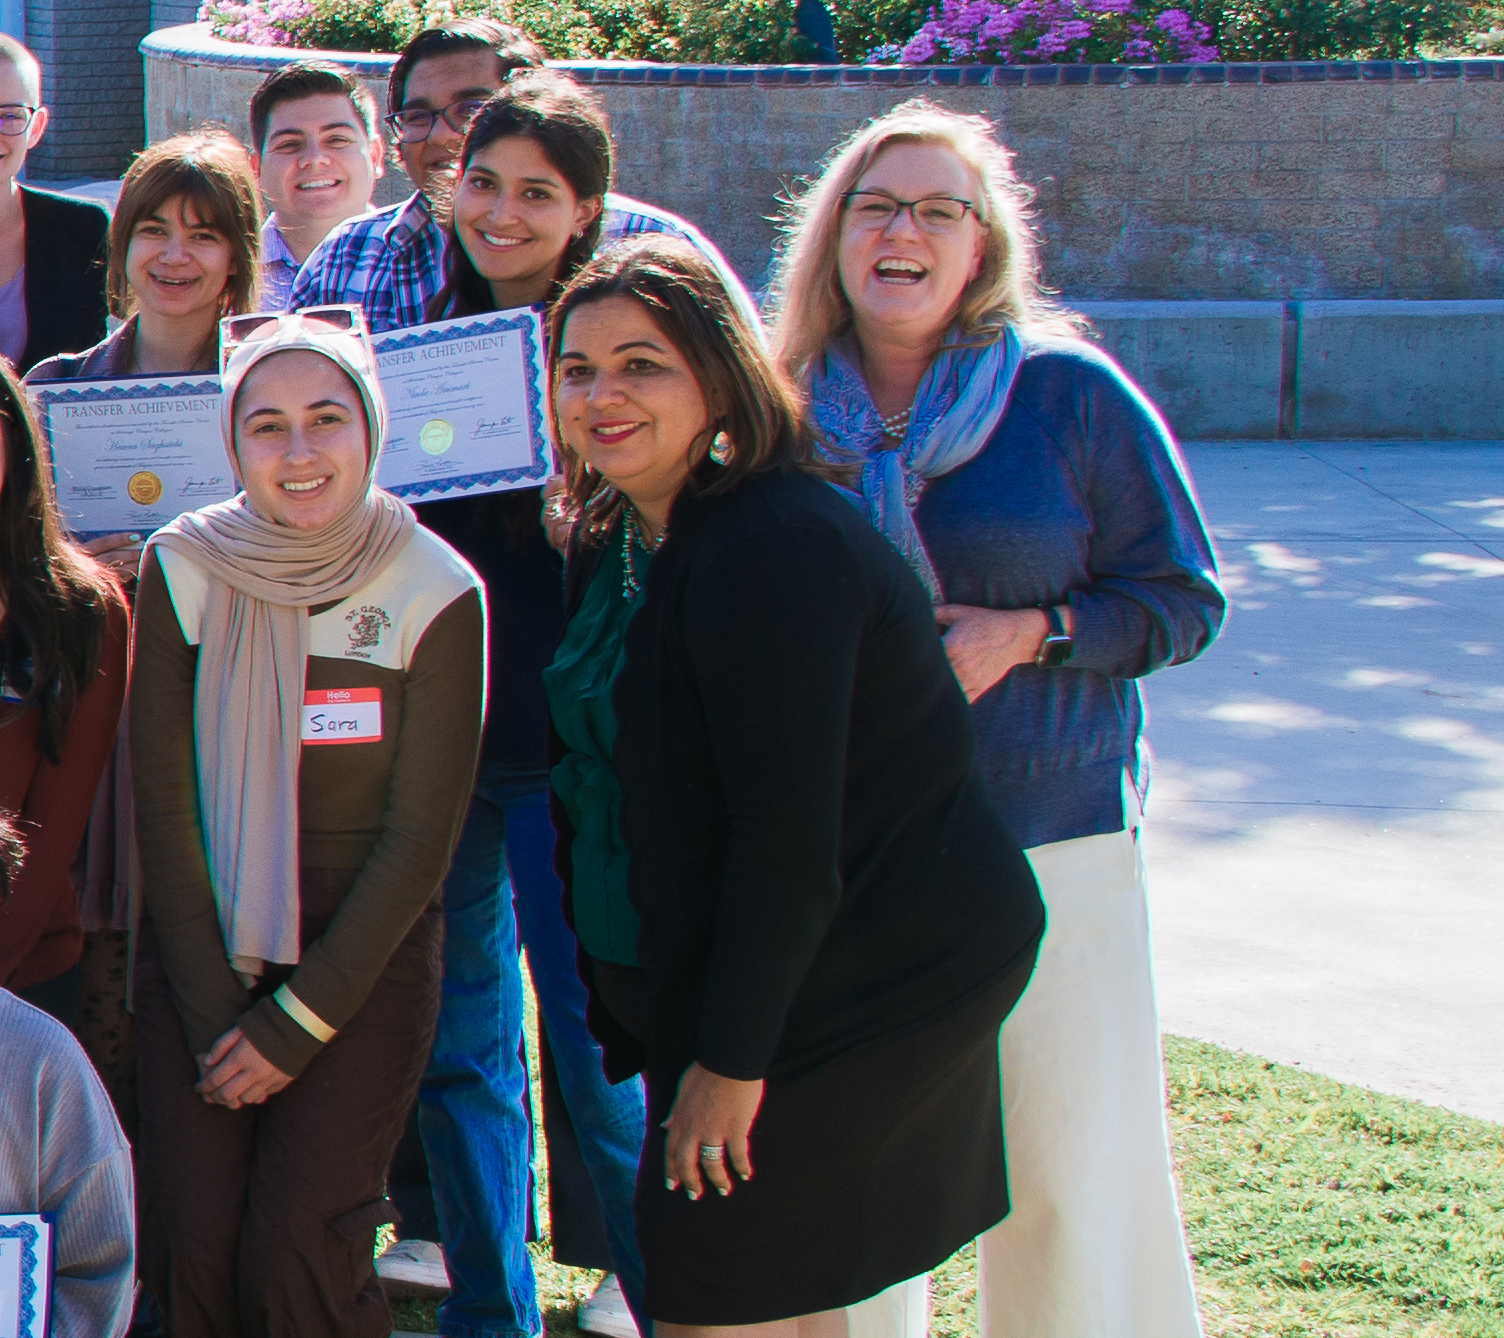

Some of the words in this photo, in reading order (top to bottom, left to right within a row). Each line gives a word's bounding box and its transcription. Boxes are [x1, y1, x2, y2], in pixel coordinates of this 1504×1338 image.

[375, 351, 416, 368] ANSFER
[419, 335, 507, 360] ACHIEVEMENT
[62, 404, 124, 418] TRANSFER
[128, 398, 218, 414] ACHIEVEMENT
[360, 606, 391, 630] GEORGE
[344, 650, 371, 659] LONDON
[326, 691, 350, 699] Hello
[310, 713, 358, 732] Sara
